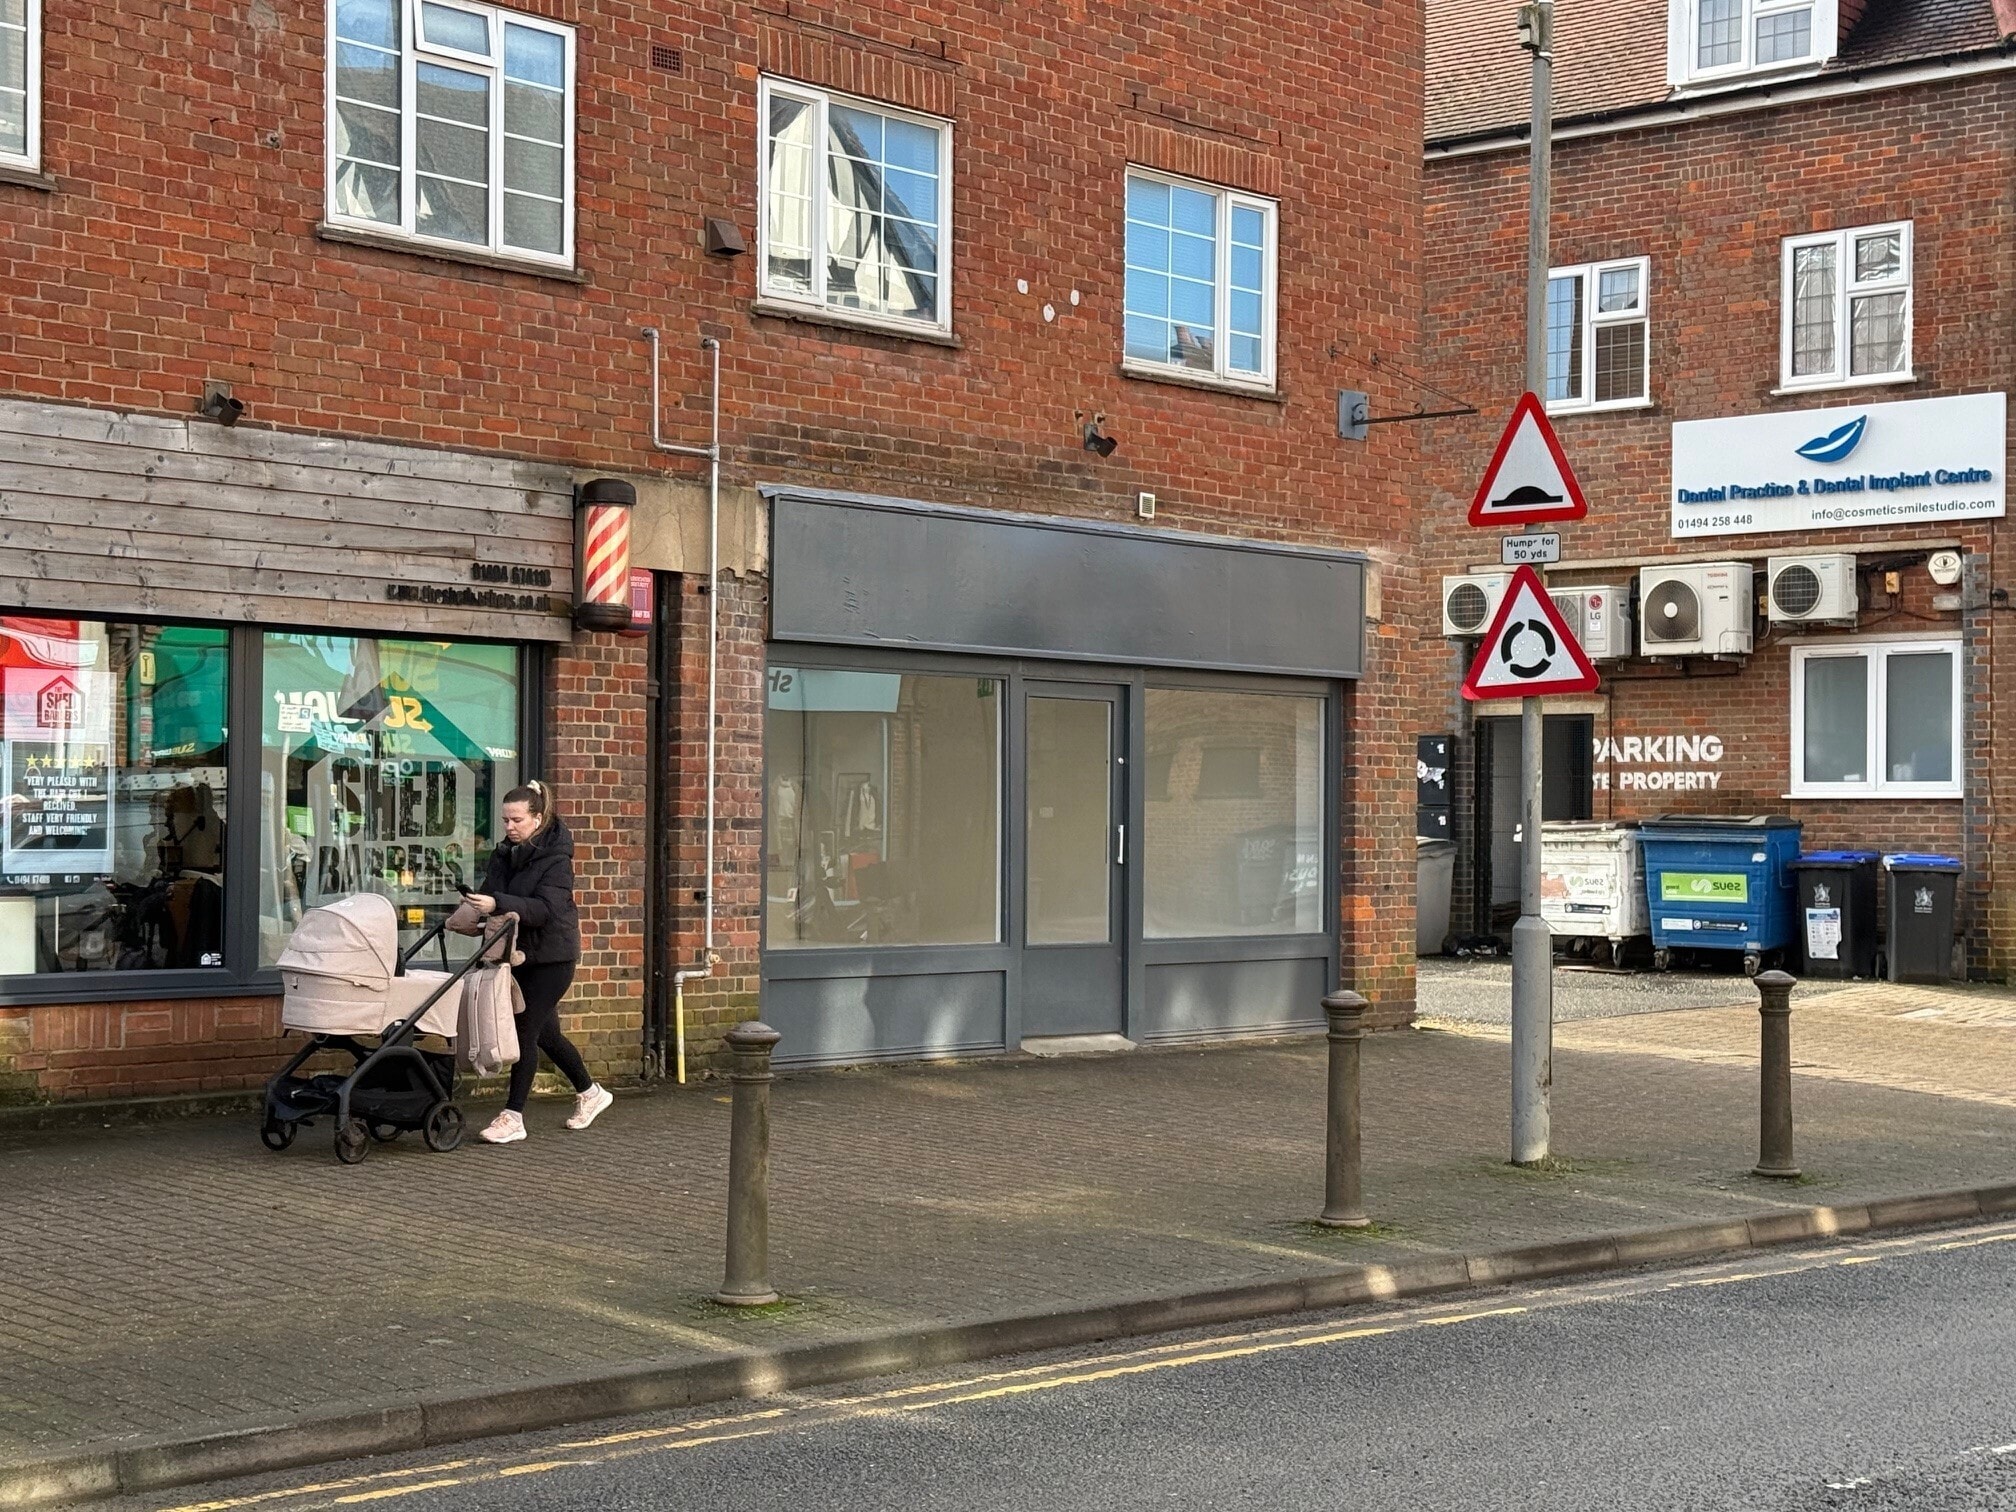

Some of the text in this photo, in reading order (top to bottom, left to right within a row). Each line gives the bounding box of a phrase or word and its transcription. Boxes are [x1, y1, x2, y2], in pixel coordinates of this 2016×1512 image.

[1678, 467, 1992, 503] Dental Practice & Dental Implant Centre
[1811, 499, 1996, 521] info@cosmeticsmilestudio.com
[1678, 515, 1753, 529] 01494 258 448
[1541, 537, 1555, 546] for
[1514, 549, 1548, 560] 50 yds
[1589, 612, 1601, 620] LG
[46, 776, 76, 787] PLEASED
[79, 776, 98, 787] WITH
[1620, 771, 1723, 790] PROPERTY
[33, 788, 47, 799] THE
[332, 757, 457, 842] SHED
[22, 813, 98, 823] STAFF VERY FRIENDLY
[28, 826, 43, 836] AND
[318, 843, 463, 896] BARBERS
[1584, 878, 1604, 886] suez
[1712, 881, 1741, 891] suez
